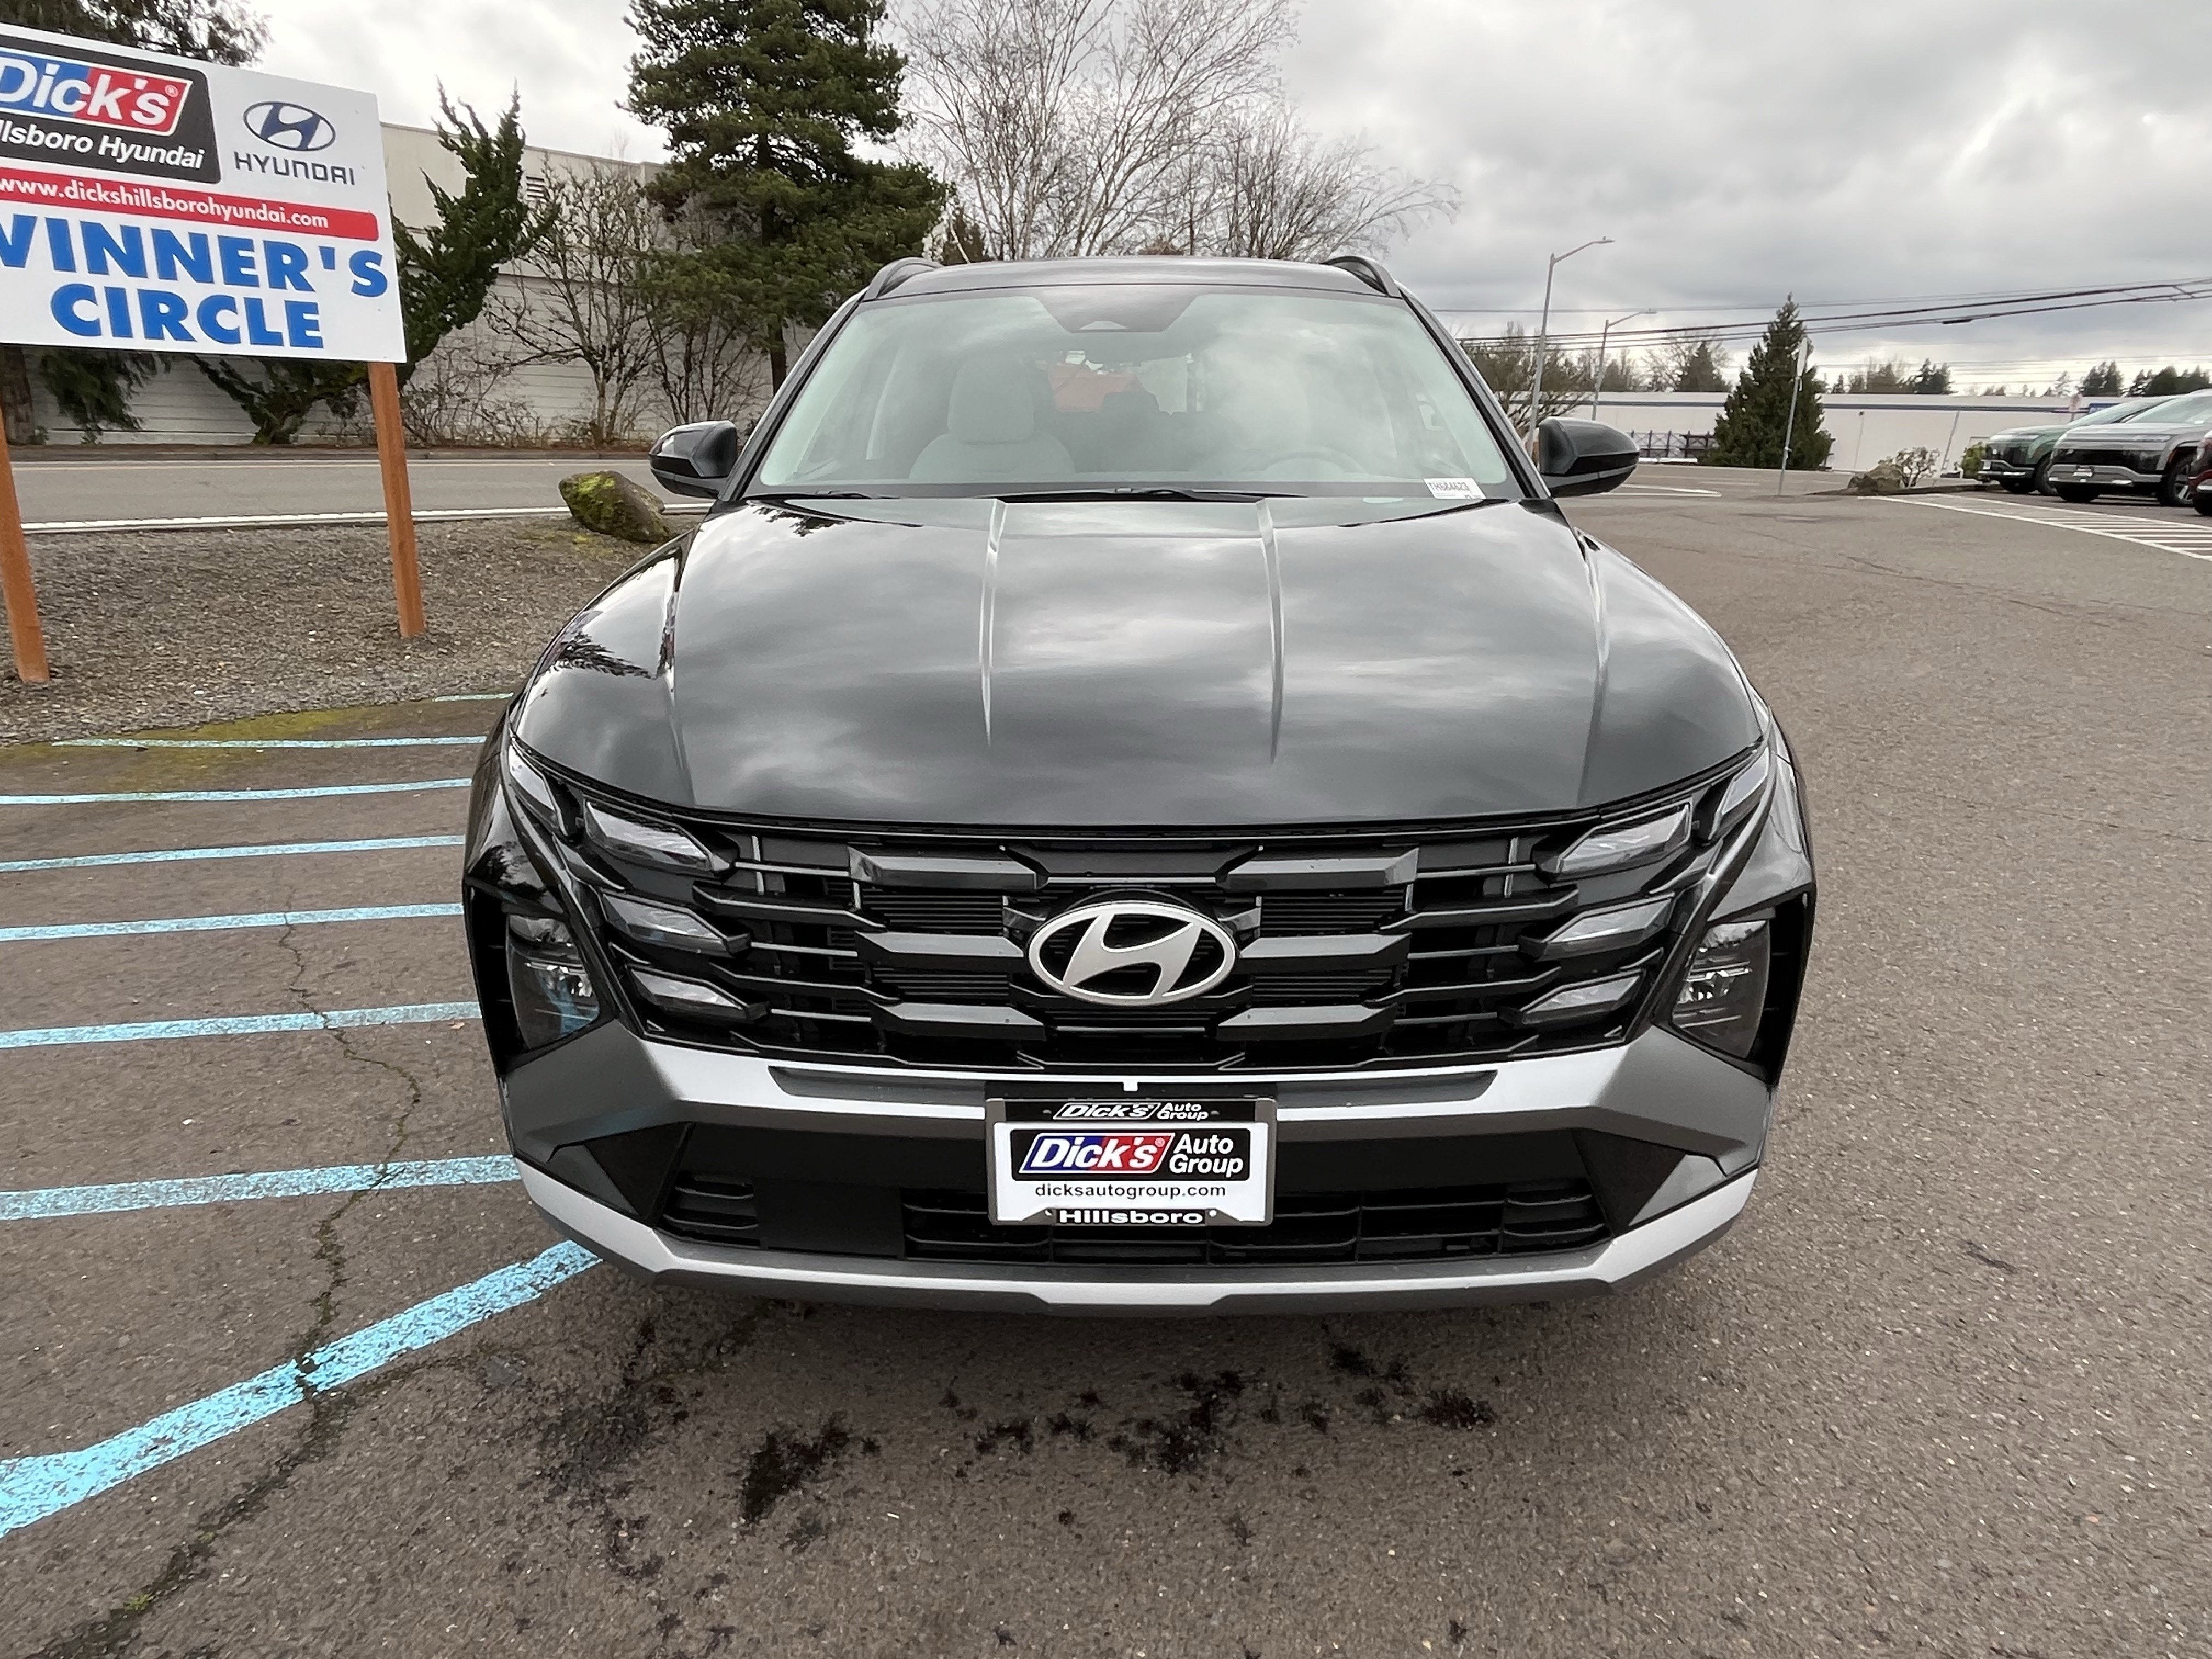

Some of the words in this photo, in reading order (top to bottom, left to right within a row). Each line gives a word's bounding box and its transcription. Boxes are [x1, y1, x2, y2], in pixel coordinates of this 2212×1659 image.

[0, 57, 170, 125] Dick's
[0, 119, 94, 153] lsboro
[98, 134, 206, 169] Hyundai
[234, 151, 356, 185] HYUNDAI
[0, 178, 329, 228] www.dickshillsborohyundai.com
[50, 283, 324, 349] CIRCLE
[1062, 1104, 1154, 1117] Dick's
[1160, 1103, 1201, 1111] Auto
[1156, 1111, 1209, 1121] Group
[1030, 1137, 1158, 1168] Dick's
[1173, 1133, 1234, 1154] Auto
[1169, 1154, 1244, 1178] Group
[1035, 1183, 1226, 1199] dicksautogroup.com
[1059, 1209, 1203, 1224] Hillsboro
